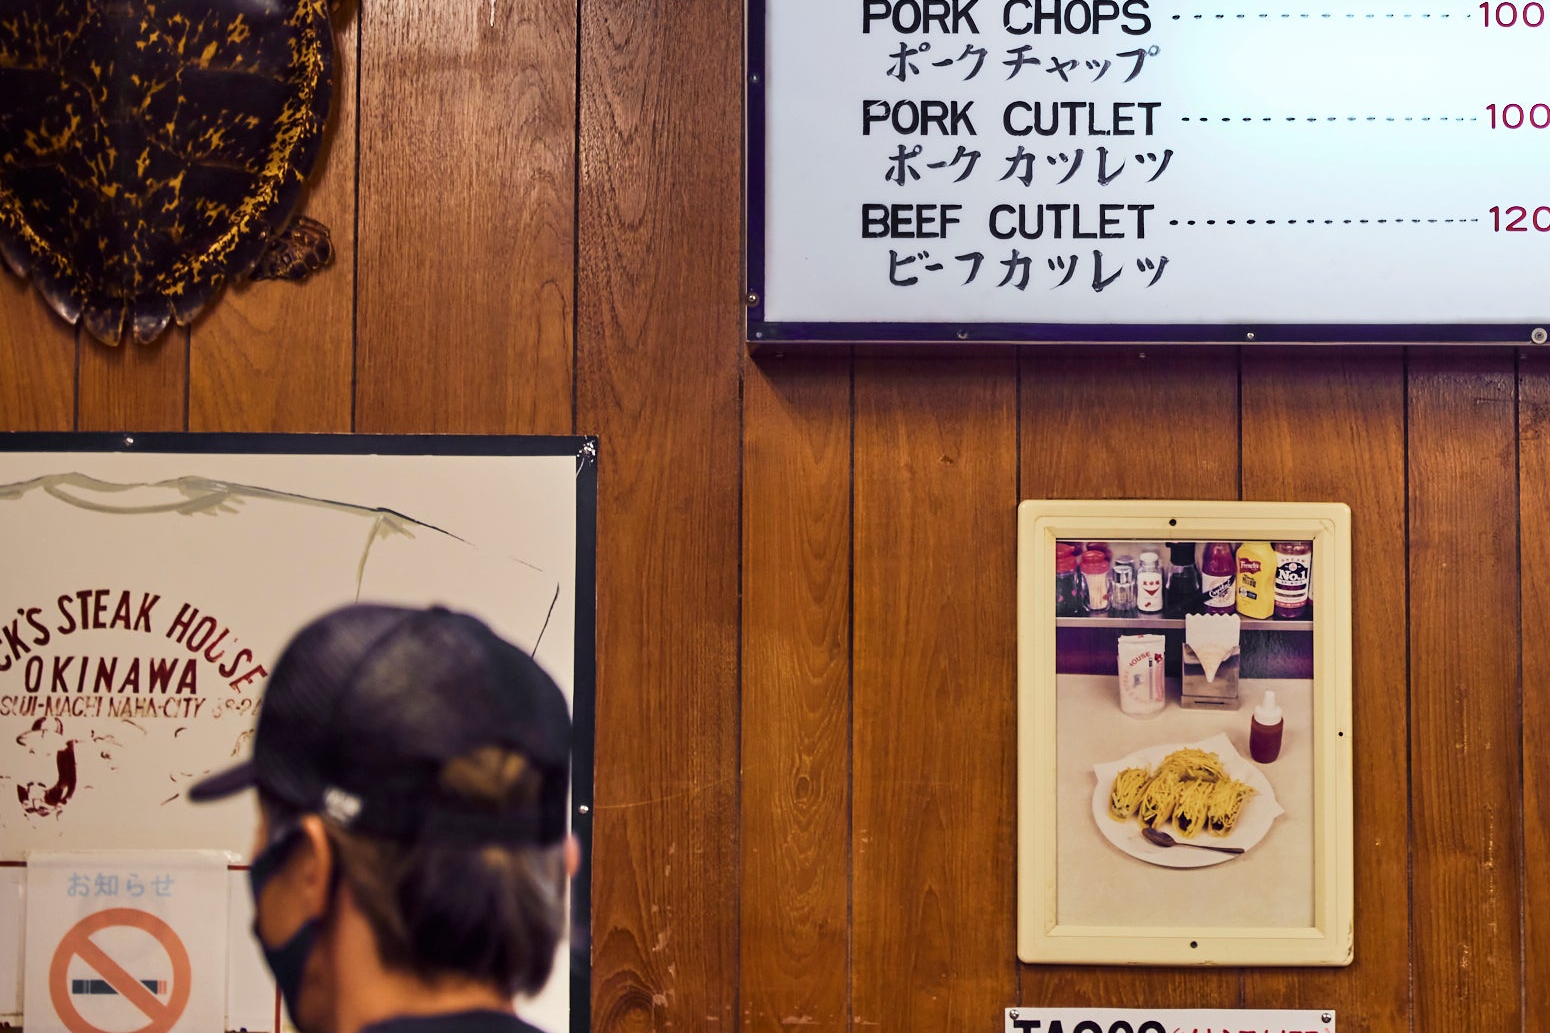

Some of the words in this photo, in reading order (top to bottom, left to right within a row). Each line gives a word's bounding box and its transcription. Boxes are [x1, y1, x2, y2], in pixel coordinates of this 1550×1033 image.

[885, 41, 989, 83] ポーク
[1001, 44, 1161, 84] チャップ
[862, 98, 978, 136] PORK
[1002, 100, 1162, 137] CUTLET
[884, 143, 982, 187] ポーク
[997, 144, 1174, 188] カツレツ
[861, 202, 963, 239] BEEF
[988, 203, 1156, 241] CUTLET
[888, 249, 985, 287] ビーフ
[995, 248, 1170, 294] カツレツ
[1279, 569, 1305, 581] No.1
[57, 589, 161, 635] STEAK
[165, 603, 269, 694] HOUSE
[24, 655, 197, 695] OKINAWA
[107, 697, 206, 718] NAHA-CITY
[66, 872, 175, 898] お知らせ
